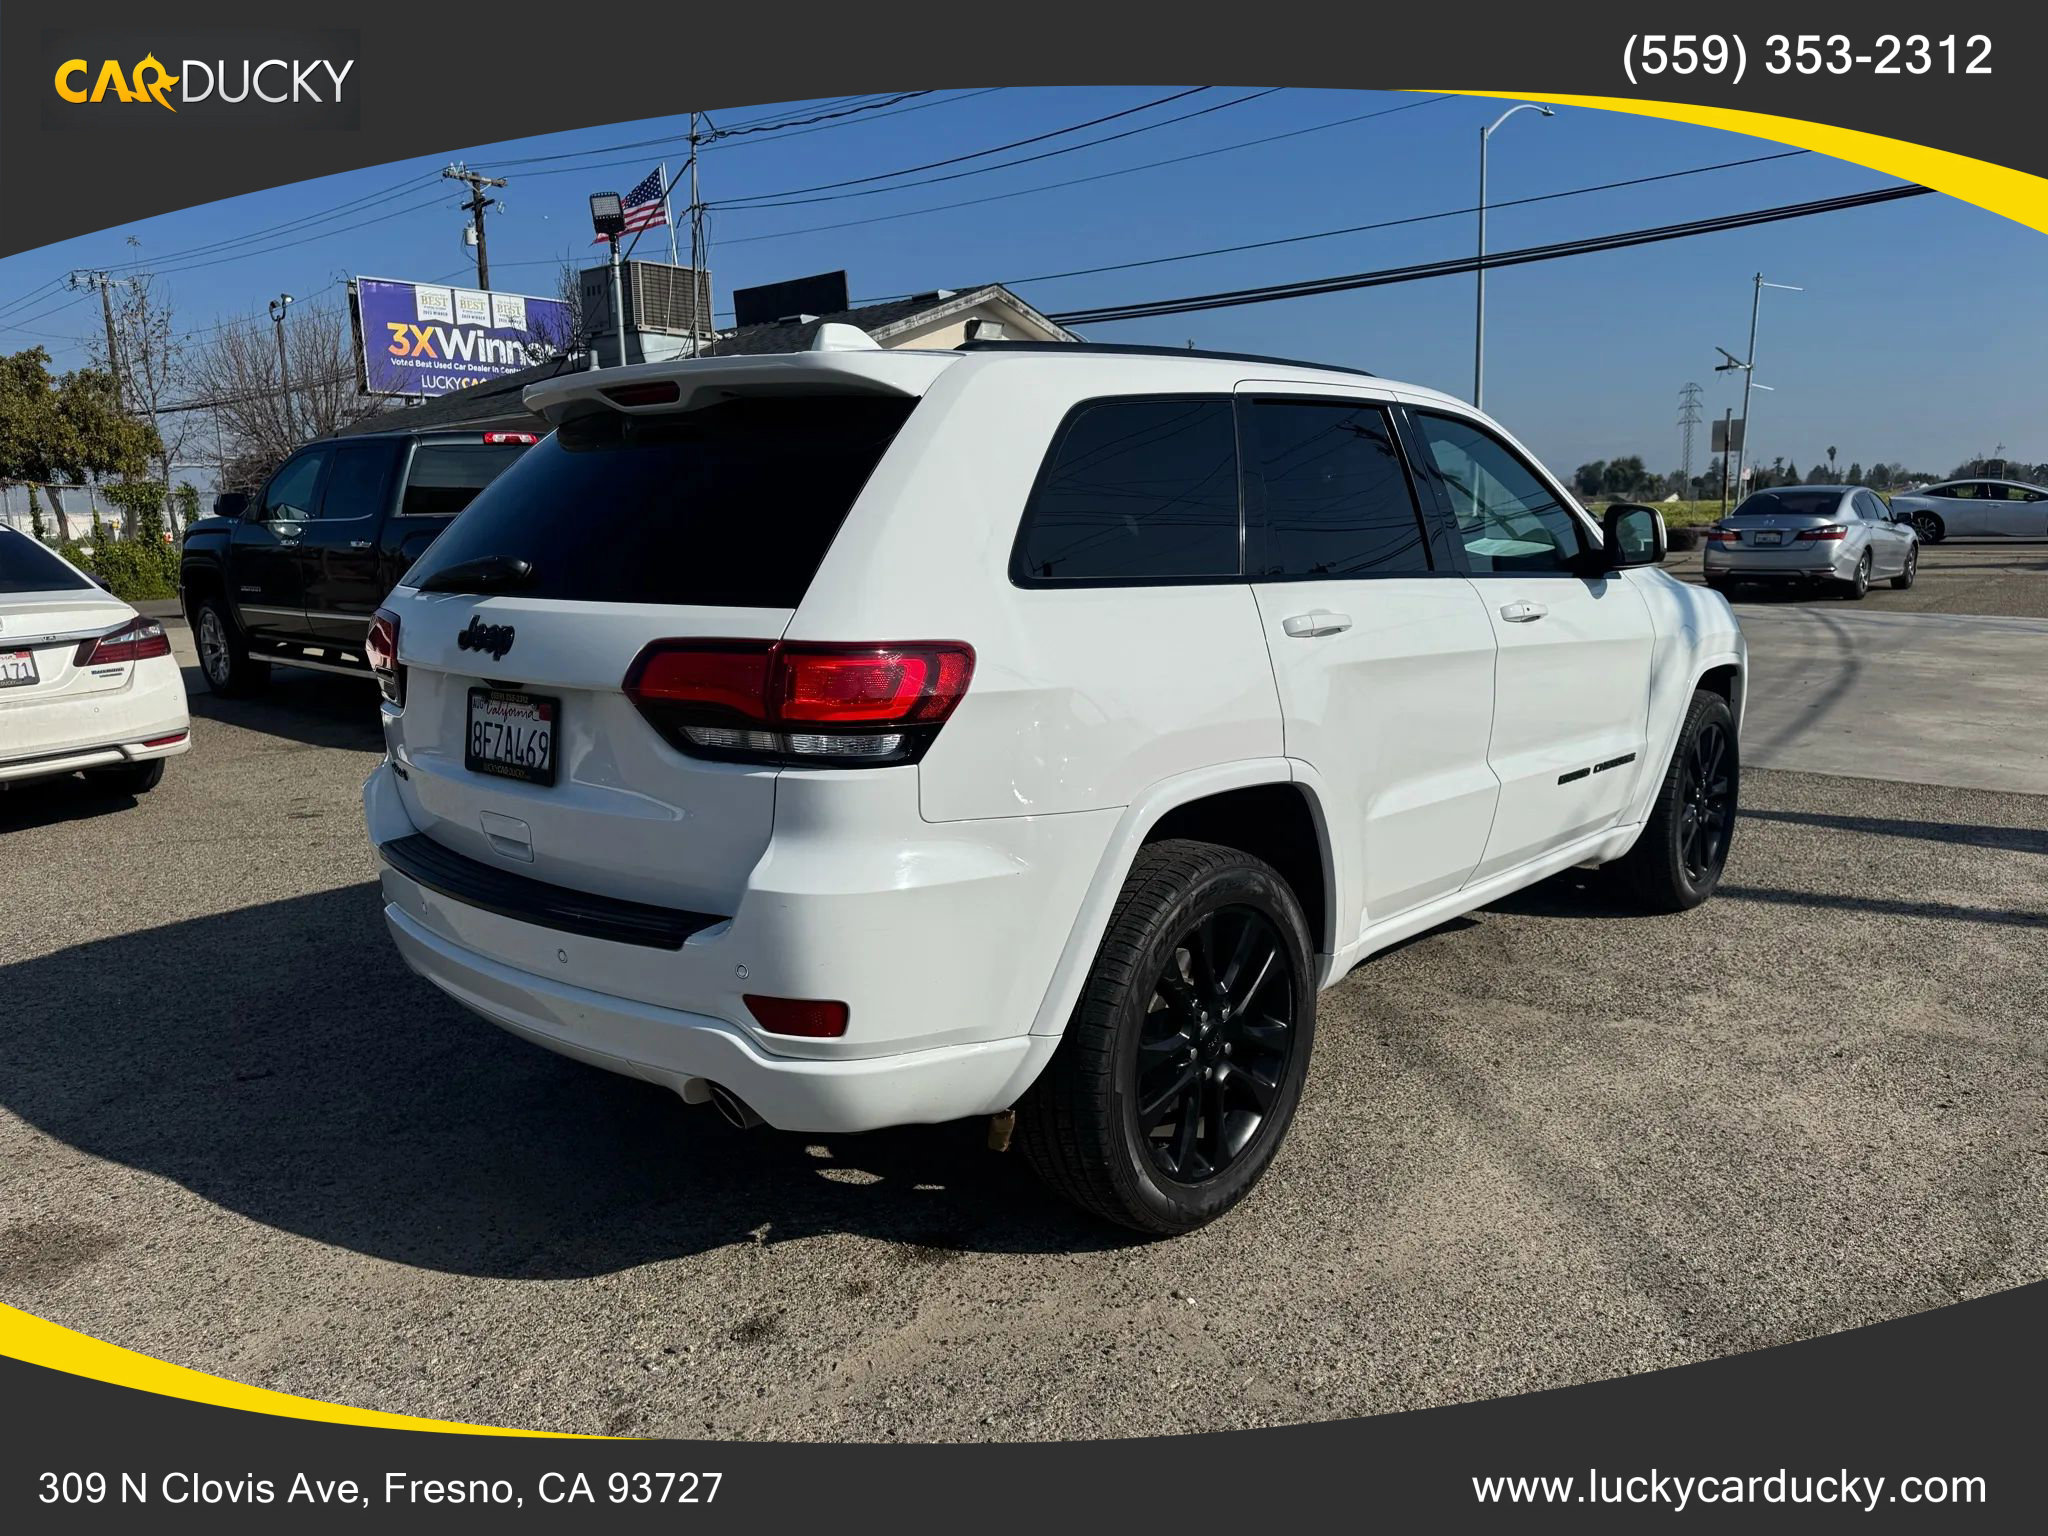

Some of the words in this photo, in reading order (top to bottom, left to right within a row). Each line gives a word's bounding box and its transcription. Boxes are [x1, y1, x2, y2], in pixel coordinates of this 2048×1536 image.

[421, 295, 448, 307] BEST
[460, 299, 486, 311] BEST
[496, 303, 523, 315] BEST
[390, 357, 414, 368] Voted
[415, 359, 432, 369] Best
[433, 360, 452, 371] Used
[453, 362, 466, 371] Car
[468, 363, 491, 374] Dealer
[458, 614, 515, 661] Jeep
[485, 699, 540, 722] California
